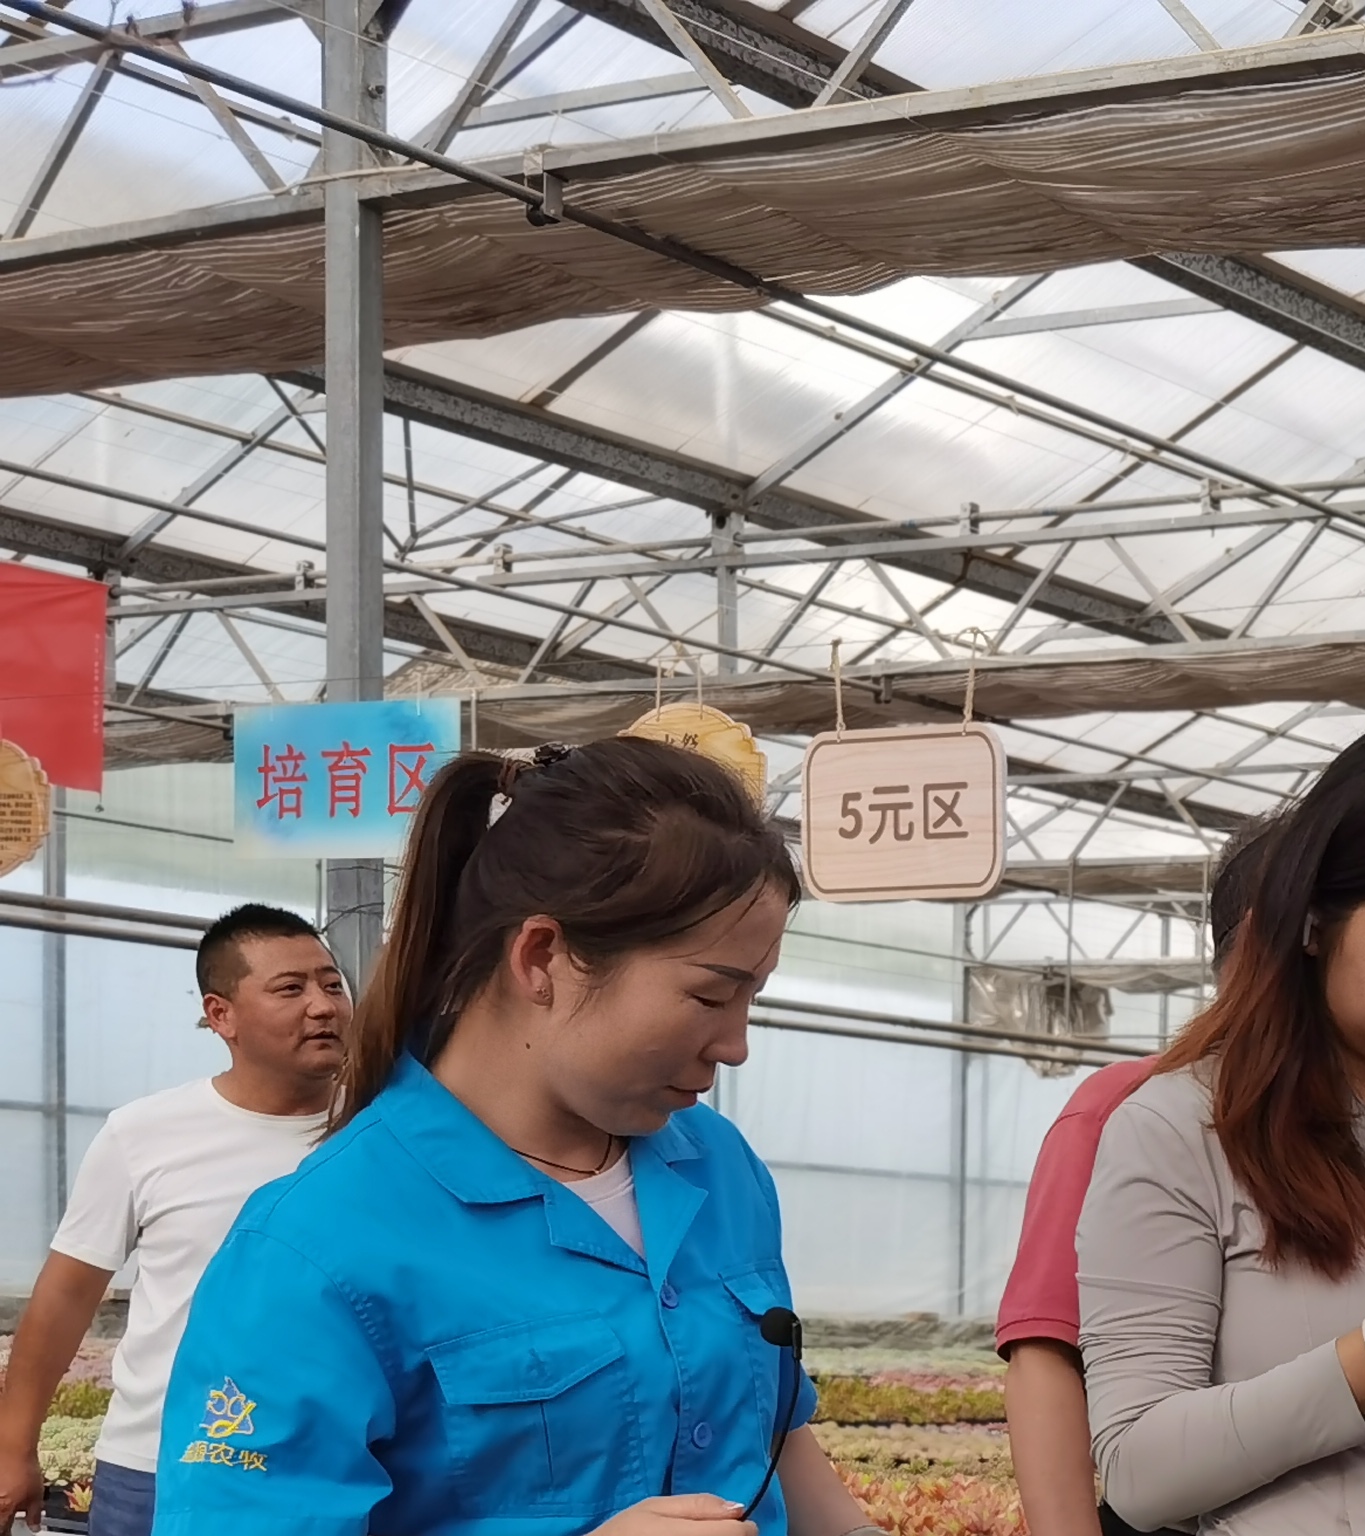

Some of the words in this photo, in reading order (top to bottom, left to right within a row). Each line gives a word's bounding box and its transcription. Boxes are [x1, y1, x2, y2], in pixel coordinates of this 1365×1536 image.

[256, 740, 435, 820] 培育区
[837, 781, 969, 846] 5元区
